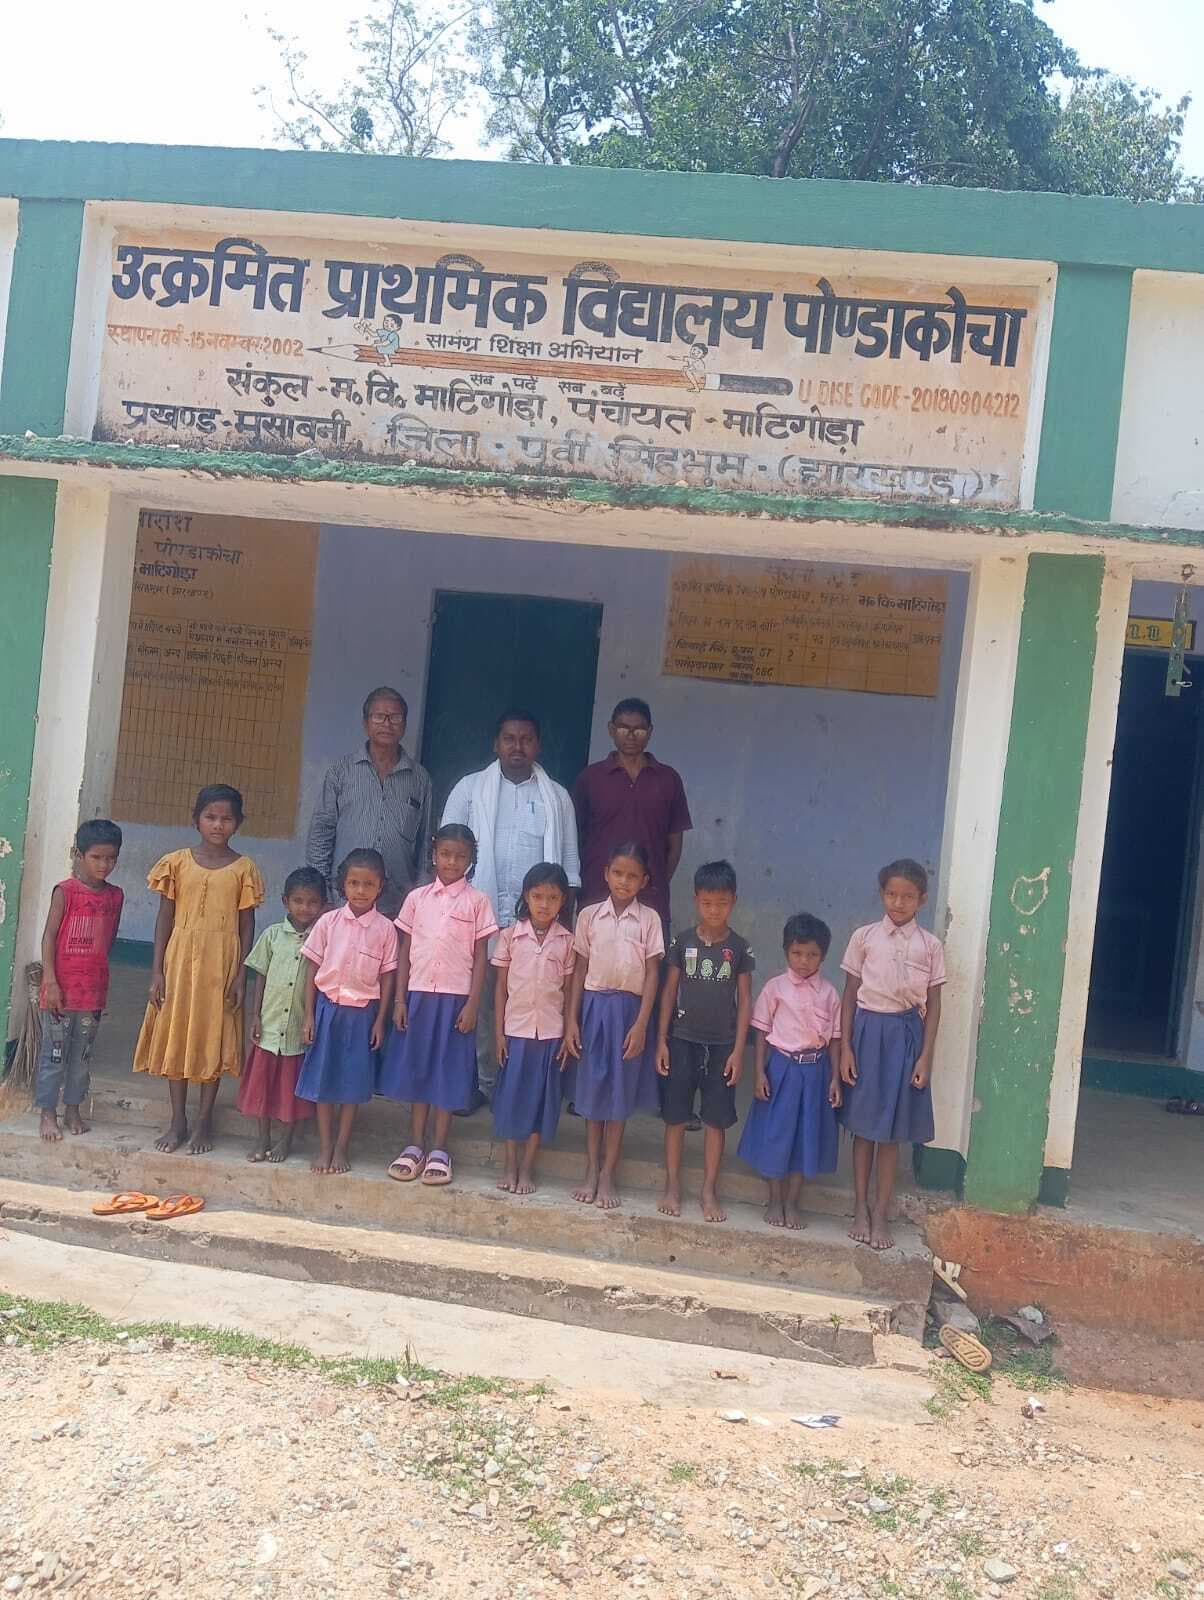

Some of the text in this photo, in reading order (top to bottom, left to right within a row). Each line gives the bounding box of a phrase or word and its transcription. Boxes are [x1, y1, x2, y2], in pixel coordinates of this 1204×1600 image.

[112, 237, 1028, 367] उत्क्रमित प्राथमिक विद्यालय पोण्डाकोचा
[489, 334, 542, 356] शिक्षा
[548, 340, 643, 363] अभियान
[470, 374, 494, 386] सब
[558, 381, 586, 394] सब
[799, 378, 812, 402] U
[226, 362, 312, 407] संकुल
[723, 402, 864, 455] माटिगोड़ा
